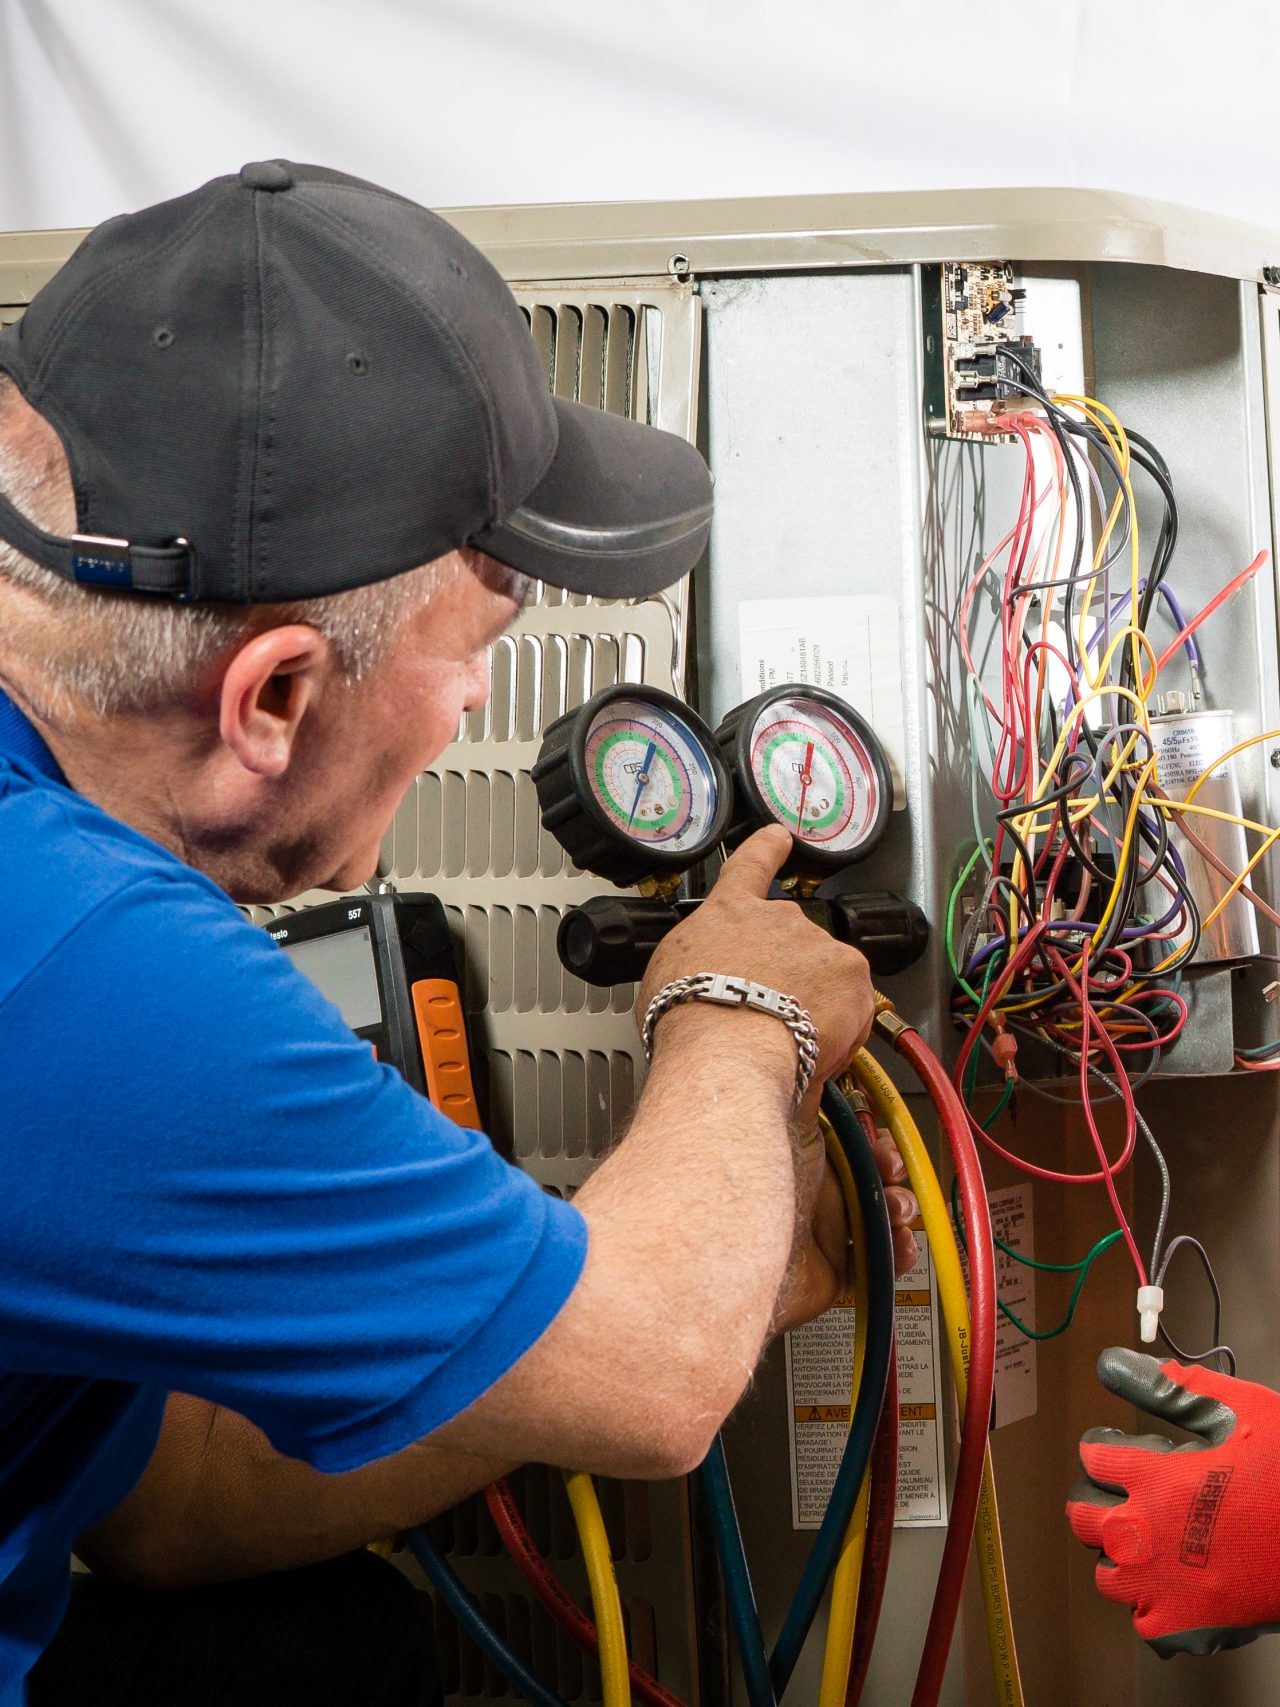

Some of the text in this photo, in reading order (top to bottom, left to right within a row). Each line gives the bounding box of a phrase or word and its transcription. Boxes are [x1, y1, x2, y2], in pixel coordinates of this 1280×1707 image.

[791, 762, 804, 774] CP
[348, 908, 361, 920] 557
[858, 1054, 895, 1104] Made in USA
[895, 1294, 912, 1303] CIA
[844, 1315, 855, 1323] LÍQ
[811, 1332, 840, 1340] PRESIÓN
[794, 1357, 844, 1365] REFRIGERANTE
[795, 1373, 822, 1381] TUBERÍA
[824, 1372, 841, 1380] ESTÁ
[825, 1407, 923, 1417] AVE ENT
[982, 1507, 992, 1534] HOSE
[987, 1544, 996, 1565] 4000
[991, 1584, 1003, 1614] BURST
[996, 1618, 1005, 1634] 800
